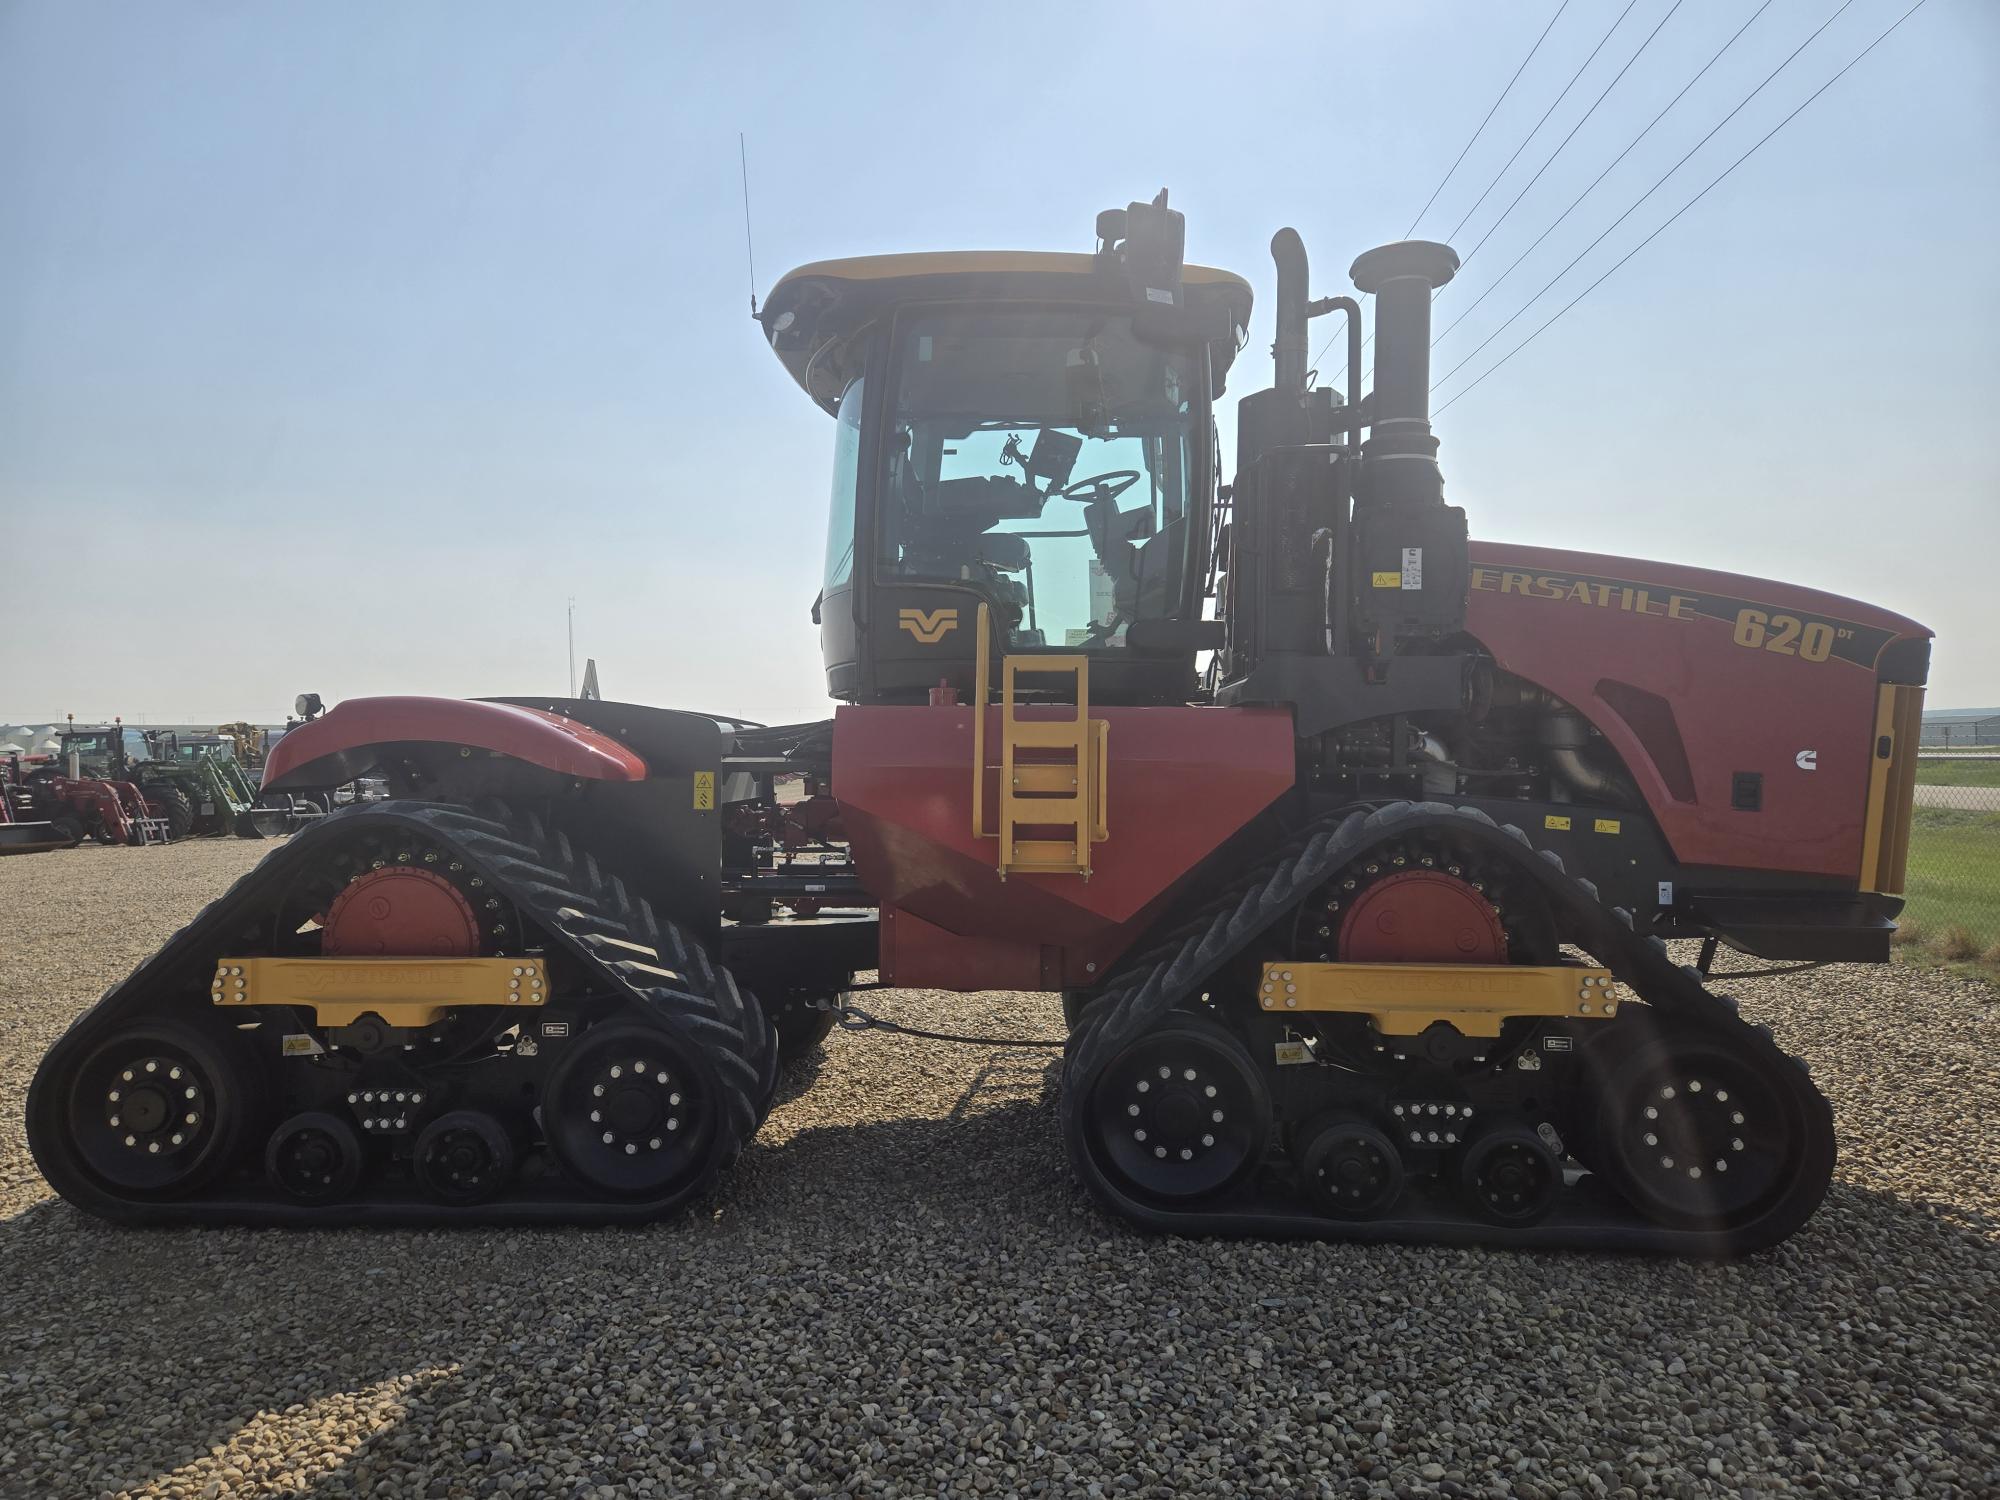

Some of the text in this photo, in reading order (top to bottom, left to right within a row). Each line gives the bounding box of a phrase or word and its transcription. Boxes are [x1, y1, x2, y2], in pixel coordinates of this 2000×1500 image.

[1471, 568, 1699, 621] ERSATILE
[1733, 608, 1855, 662] 620 DT
